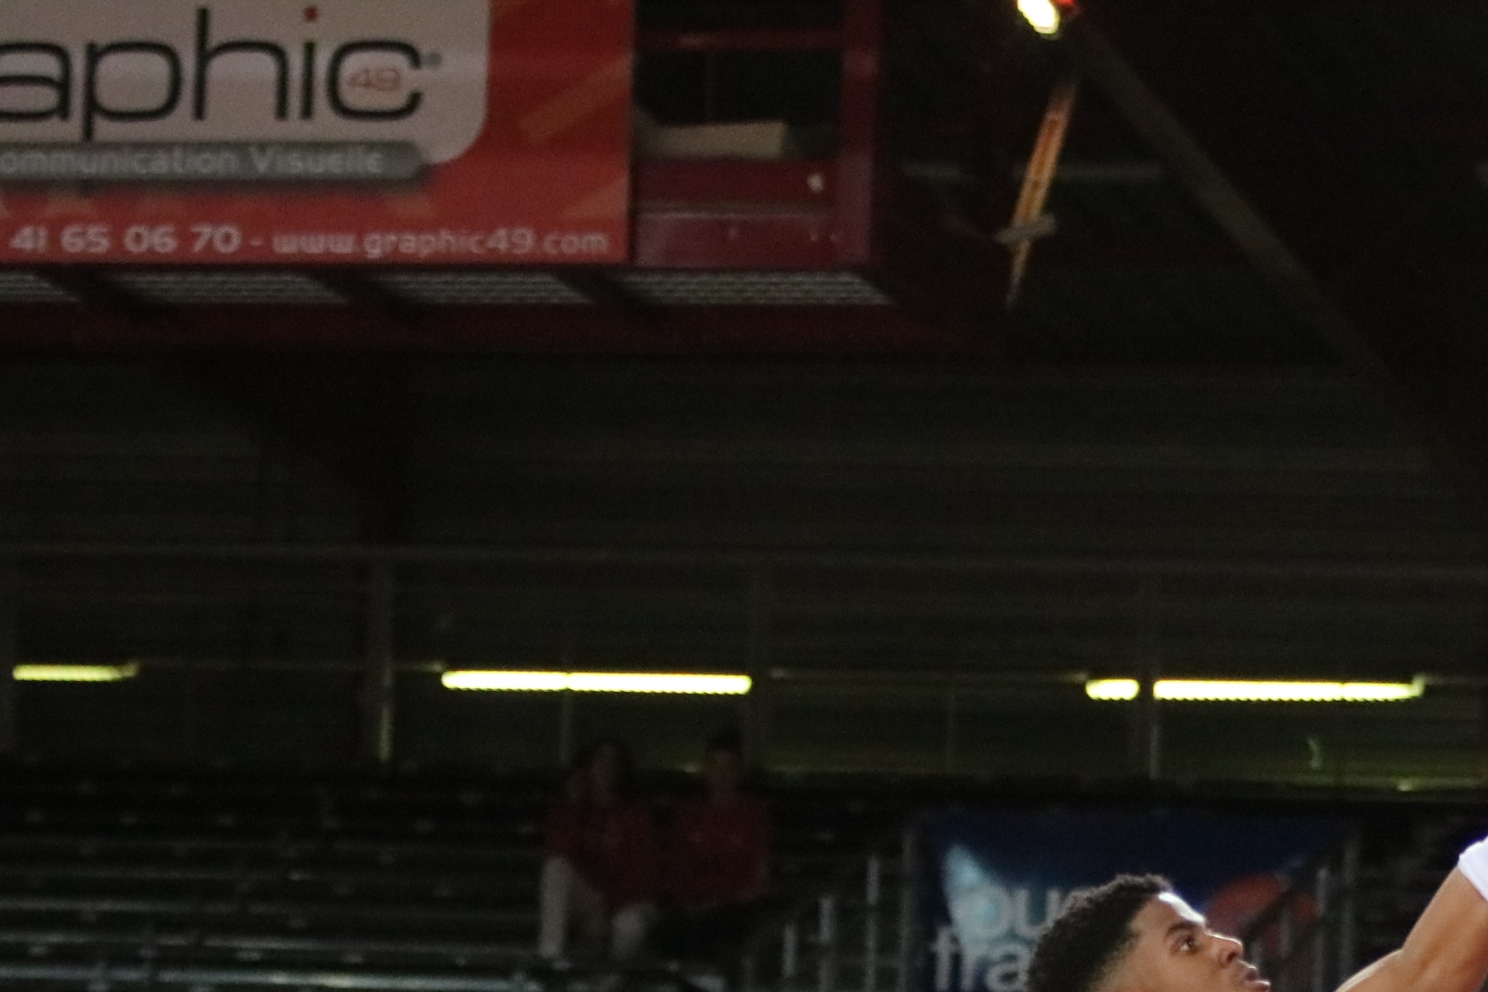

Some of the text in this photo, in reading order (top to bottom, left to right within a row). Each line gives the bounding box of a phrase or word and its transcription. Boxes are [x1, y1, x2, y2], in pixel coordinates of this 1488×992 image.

[60, 224, 110, 253] 65
[123, 224, 177, 253] 06
[189, 224, 242, 253] 70
